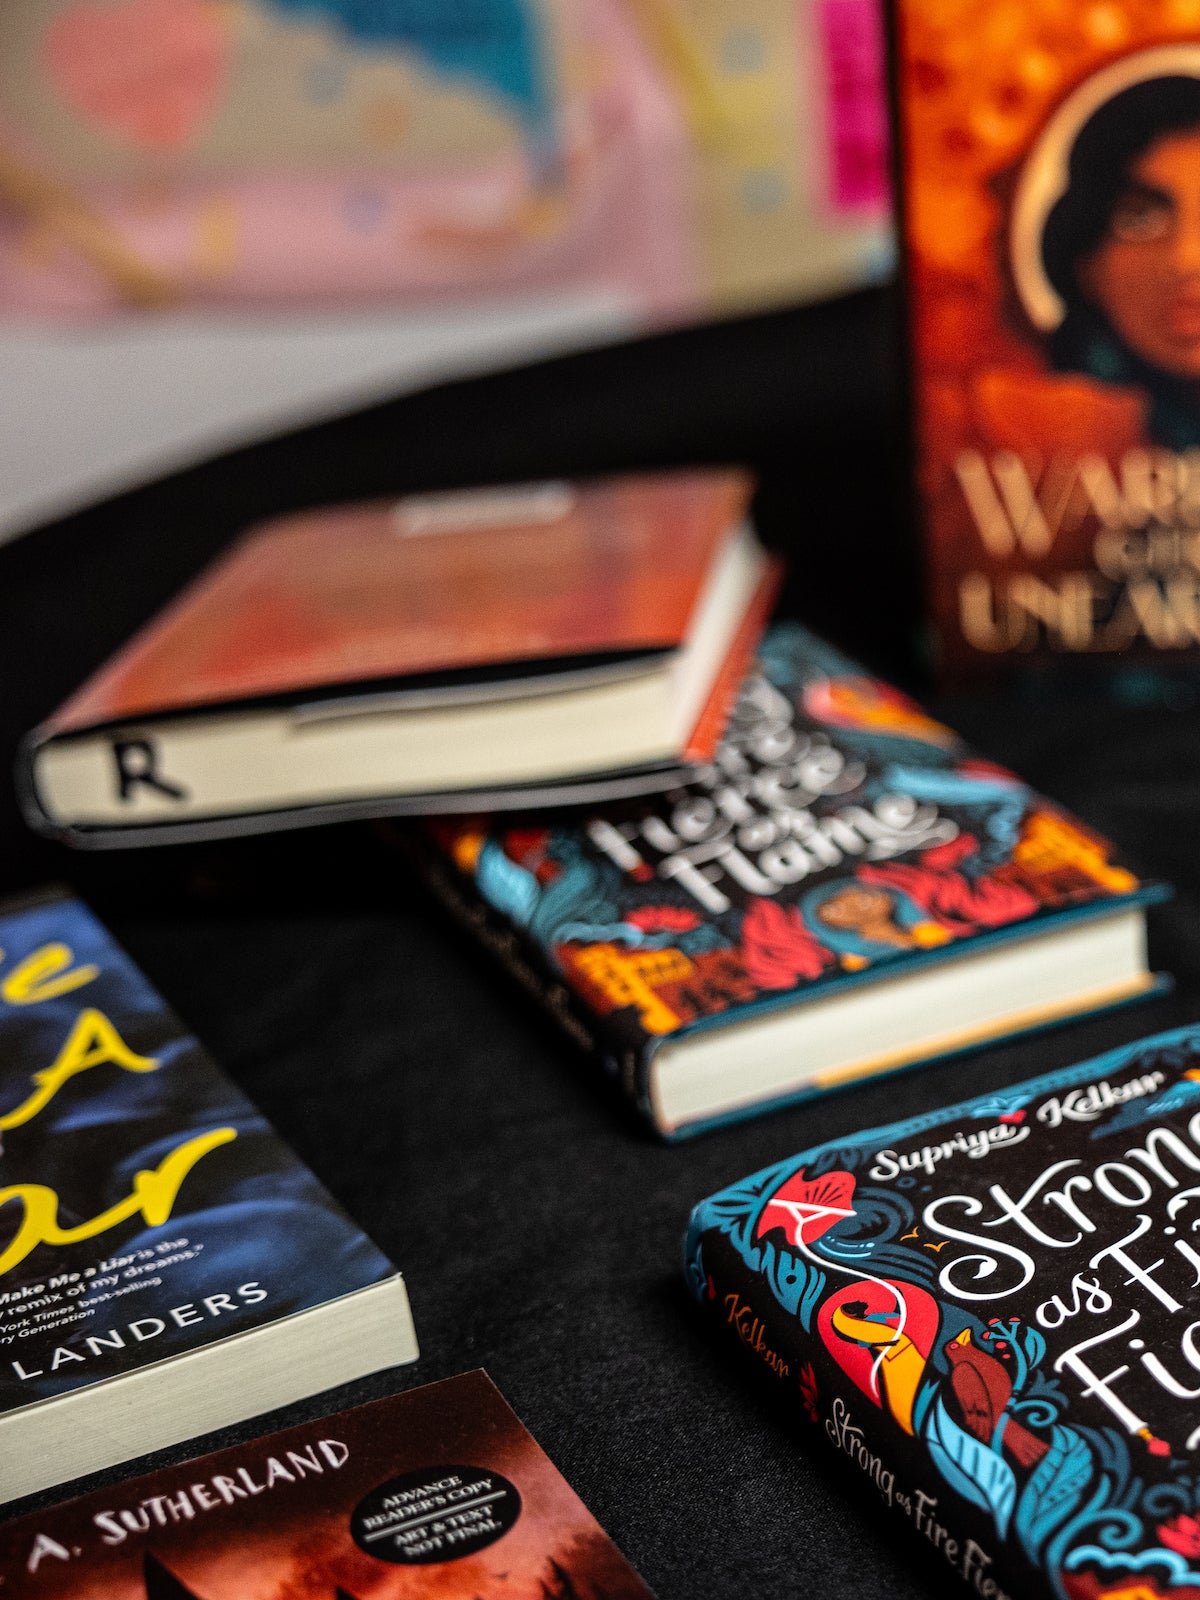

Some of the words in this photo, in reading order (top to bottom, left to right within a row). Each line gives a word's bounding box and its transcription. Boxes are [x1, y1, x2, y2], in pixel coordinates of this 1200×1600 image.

[112, 740, 186, 801] R
[657, 794, 960, 914] Flame
[868, 1123, 1031, 1182] Supriya
[1036, 1070, 1166, 1128] Kelkar
[50, 1271, 81, 1290] Me
[84, 1267, 97, 1278] a
[100, 1252, 138, 1273] Liar
[138, 1248, 154, 1261] is
[155, 1237, 190, 1253] the
[0, 1314, 31, 1334] York
[33, 1304, 75, 1324] Times
[78, 1276, 163, 1309] best-selling
[8, 1292, 63, 1316] remix
[66, 1281, 87, 1297] of
[90, 1273, 119, 1290] my
[18, 1307, 96, 1339] Generation
[1035, 1268, 1112, 1329] as
[11, 1281, 269, 1381] LANDERS
[724, 1294, 790, 1377] Kelkar
[27, 1532, 82, 1574] A.
[93, 1439, 350, 1546] SUTHERLAND
[362, 1494, 447, 1530] READER'S
[447, 1478, 493, 1501] COPY
[382, 1474, 463, 1510] ADVANCE
[825, 1397, 896, 1508] Strong
[895, 1490, 912, 1516] as
[913, 1488, 959, 1565] Fire
[393, 1526, 429, 1547] ART
[431, 1521, 447, 1535] &
[446, 1504, 494, 1529] TEXT
[402, 1535, 444, 1558] NOT
